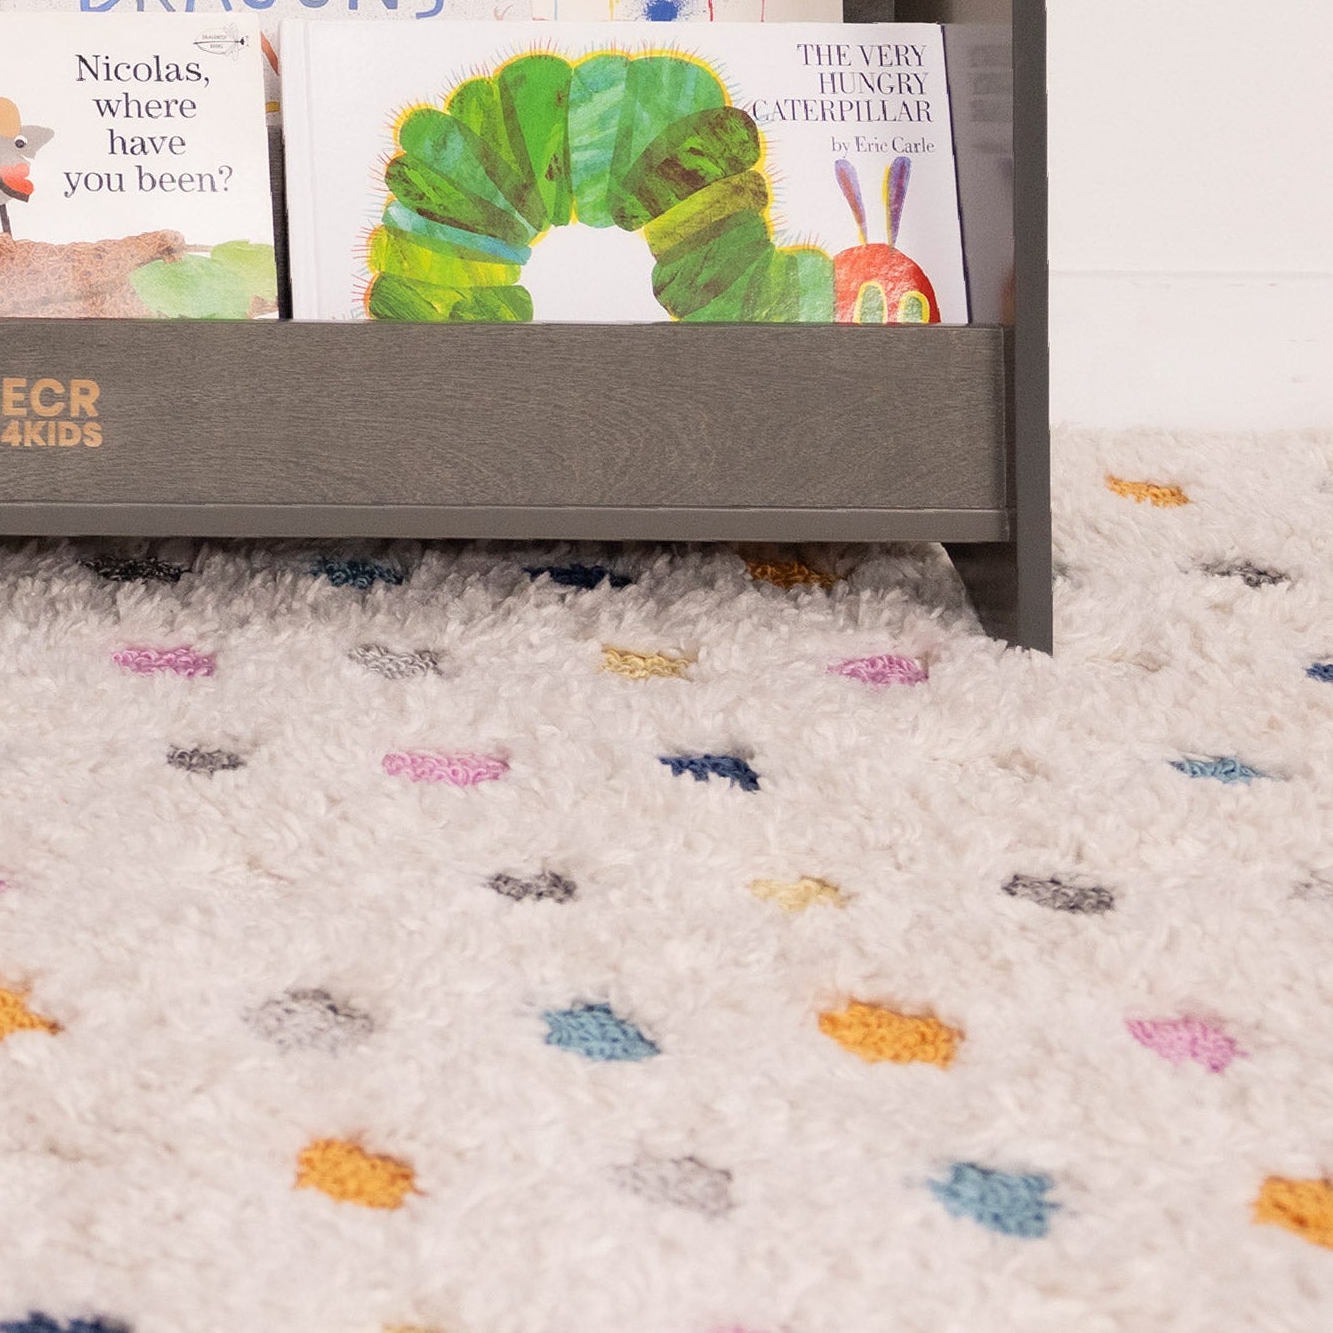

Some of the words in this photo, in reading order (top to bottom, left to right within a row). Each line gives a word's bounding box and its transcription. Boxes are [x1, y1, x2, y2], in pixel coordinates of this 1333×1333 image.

[796, 43, 852, 66] THE
[858, 44, 928, 67] VERY
[75, 53, 211, 88] Nicolas,
[818, 72, 929, 95] HUNGRY
[93, 92, 197, 119] where
[752, 99, 934, 123] CATERPILLAR
[107, 129, 187, 157] have
[830, 136, 850, 159] by
[855, 136, 888, 153] Eric
[891, 136, 935, 154] Carle
[63, 169, 125, 199] you
[137, 165, 234, 193] been?
[2, 377, 101, 418] ECR
[0, 420, 103, 448] 4KIDS
